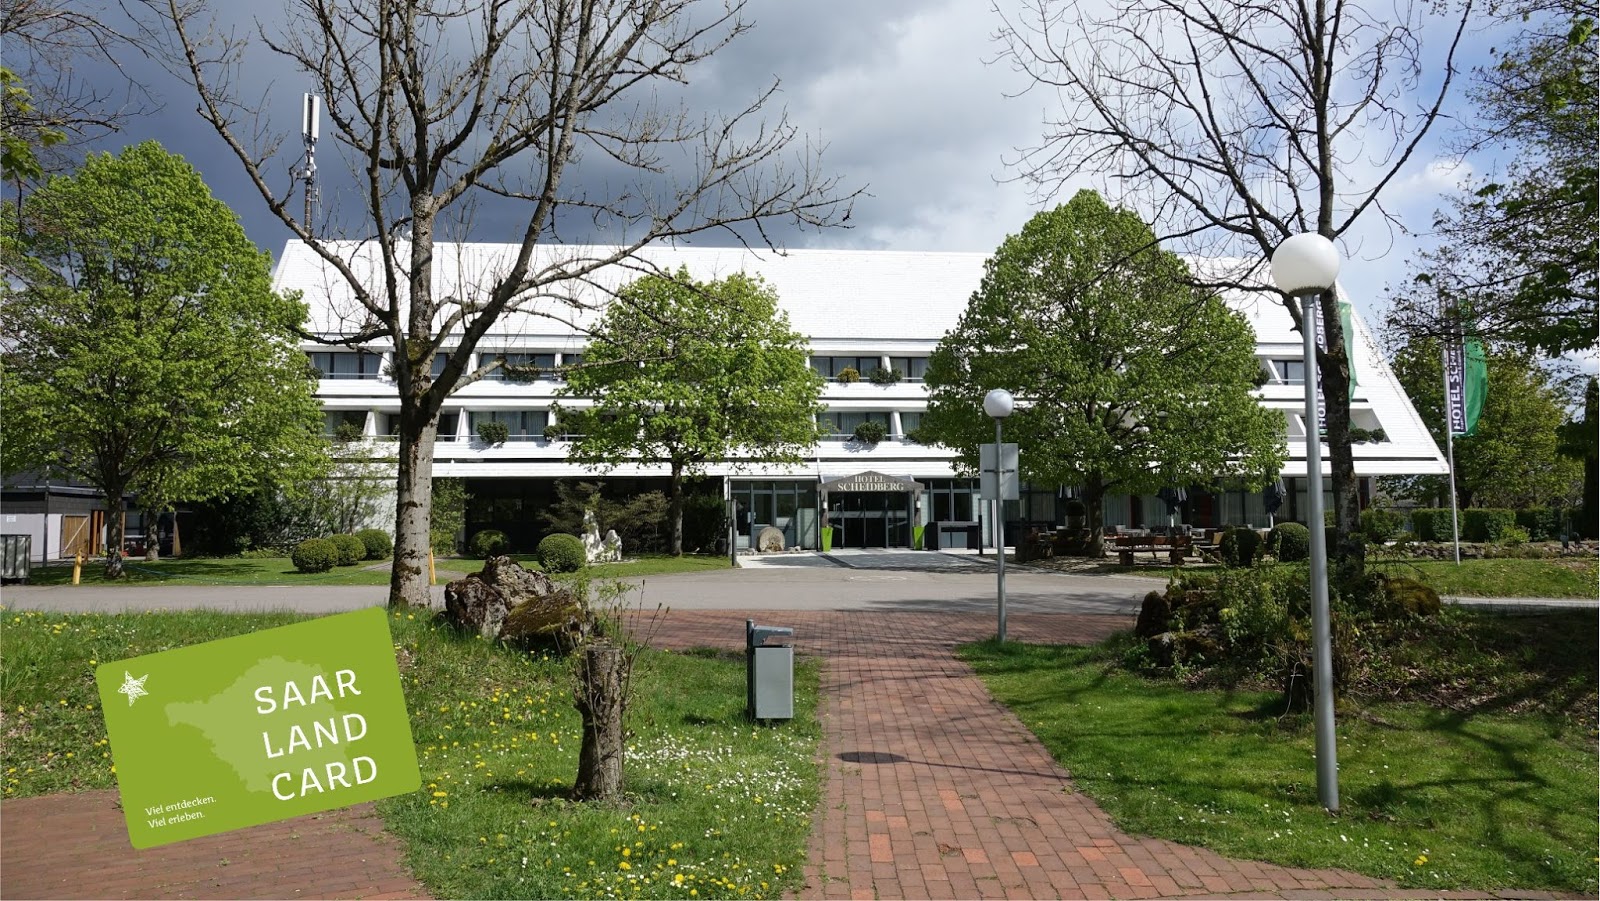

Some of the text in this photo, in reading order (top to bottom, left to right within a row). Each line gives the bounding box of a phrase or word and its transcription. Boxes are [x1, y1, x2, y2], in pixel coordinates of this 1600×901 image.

[1450, 385, 1461, 430] HOTEL
[854, 475, 885, 483] HOTEL
[837, 482, 904, 492] SCHEIDBERG
